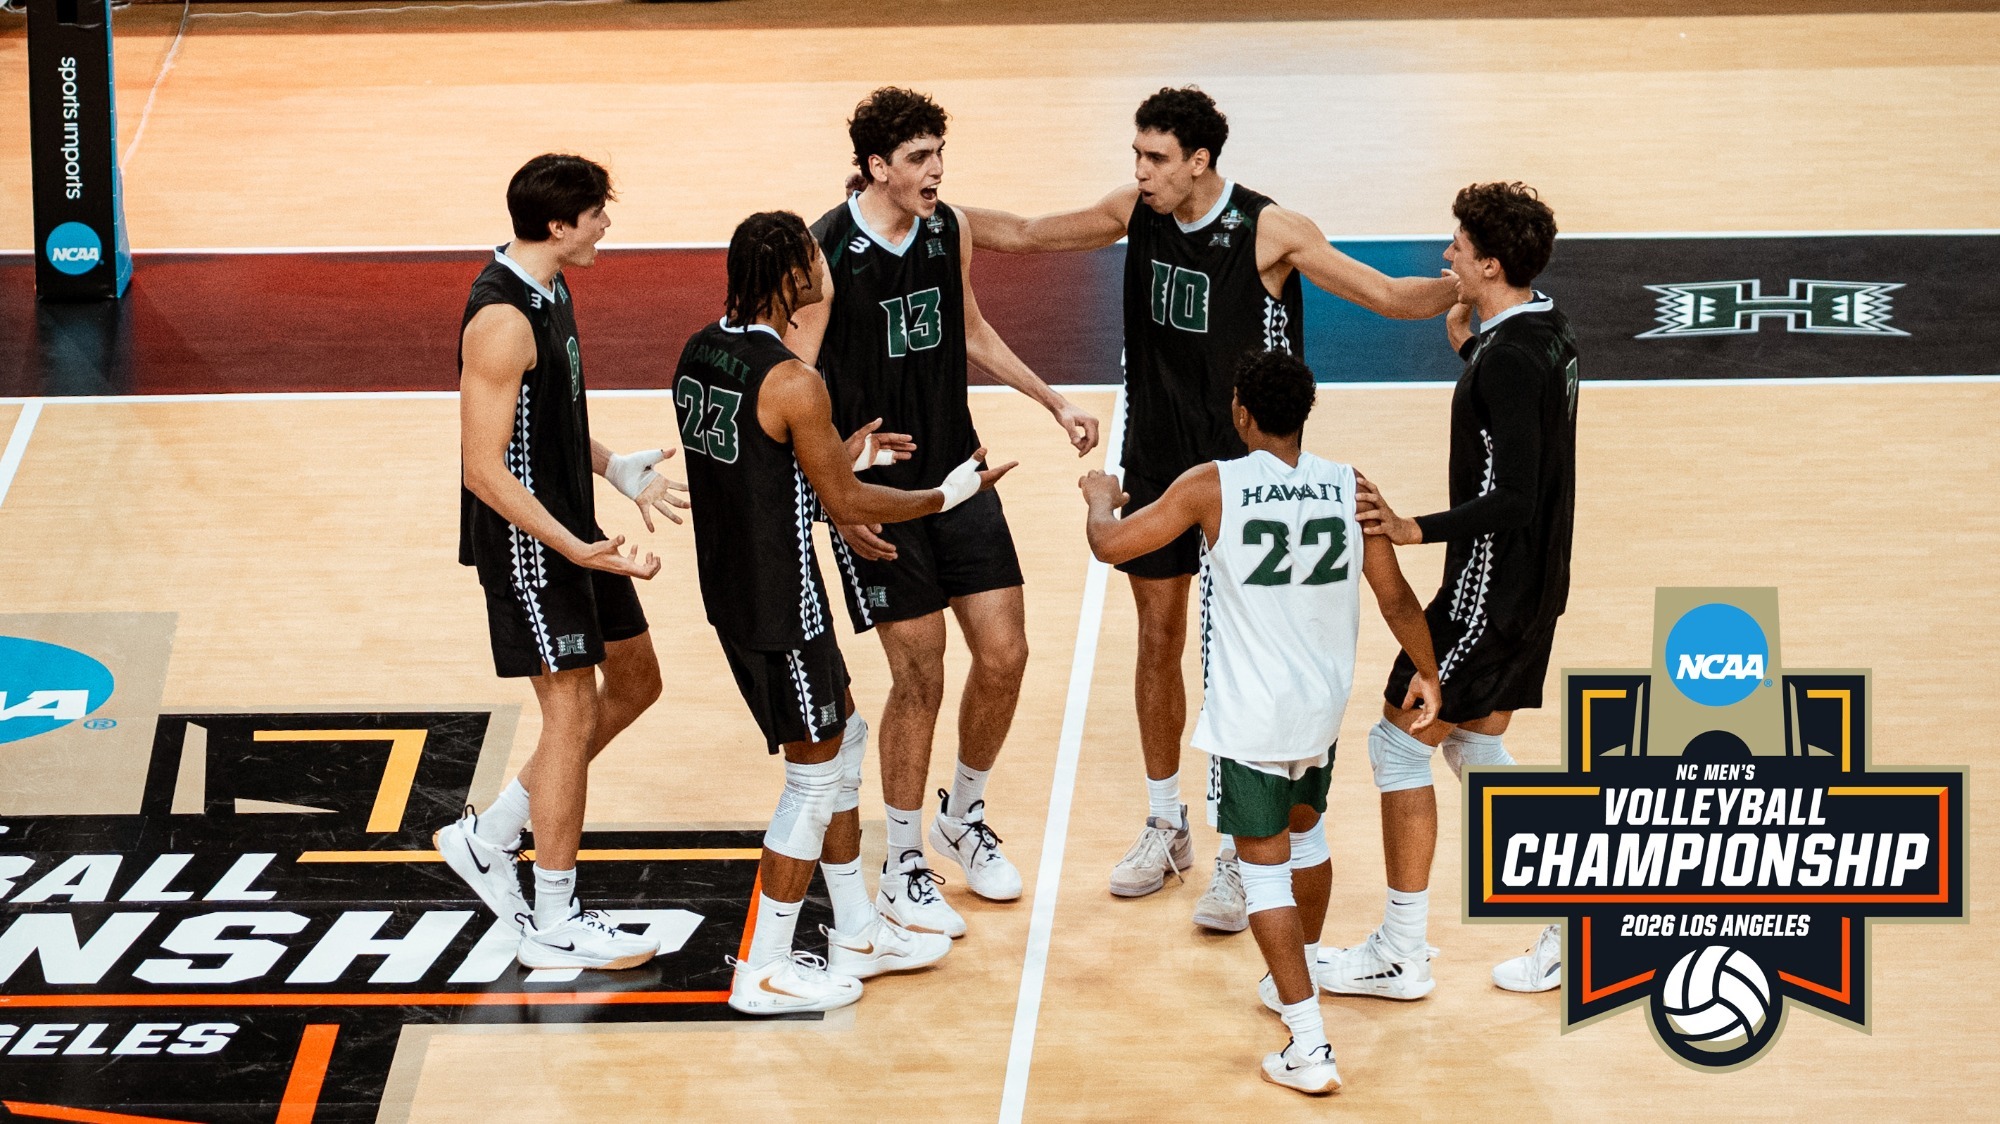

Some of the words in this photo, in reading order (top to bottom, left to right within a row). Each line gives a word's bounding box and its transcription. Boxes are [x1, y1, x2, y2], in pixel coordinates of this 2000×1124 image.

[58, 56, 80, 119] sports
[60, 122, 83, 200] imports
[52, 247, 99, 261] NCAA
[879, 287, 942, 357] 13
[1151, 259, 1210, 333] 10
[677, 375, 742, 464] 23
[1241, 516, 1349, 586] 22
